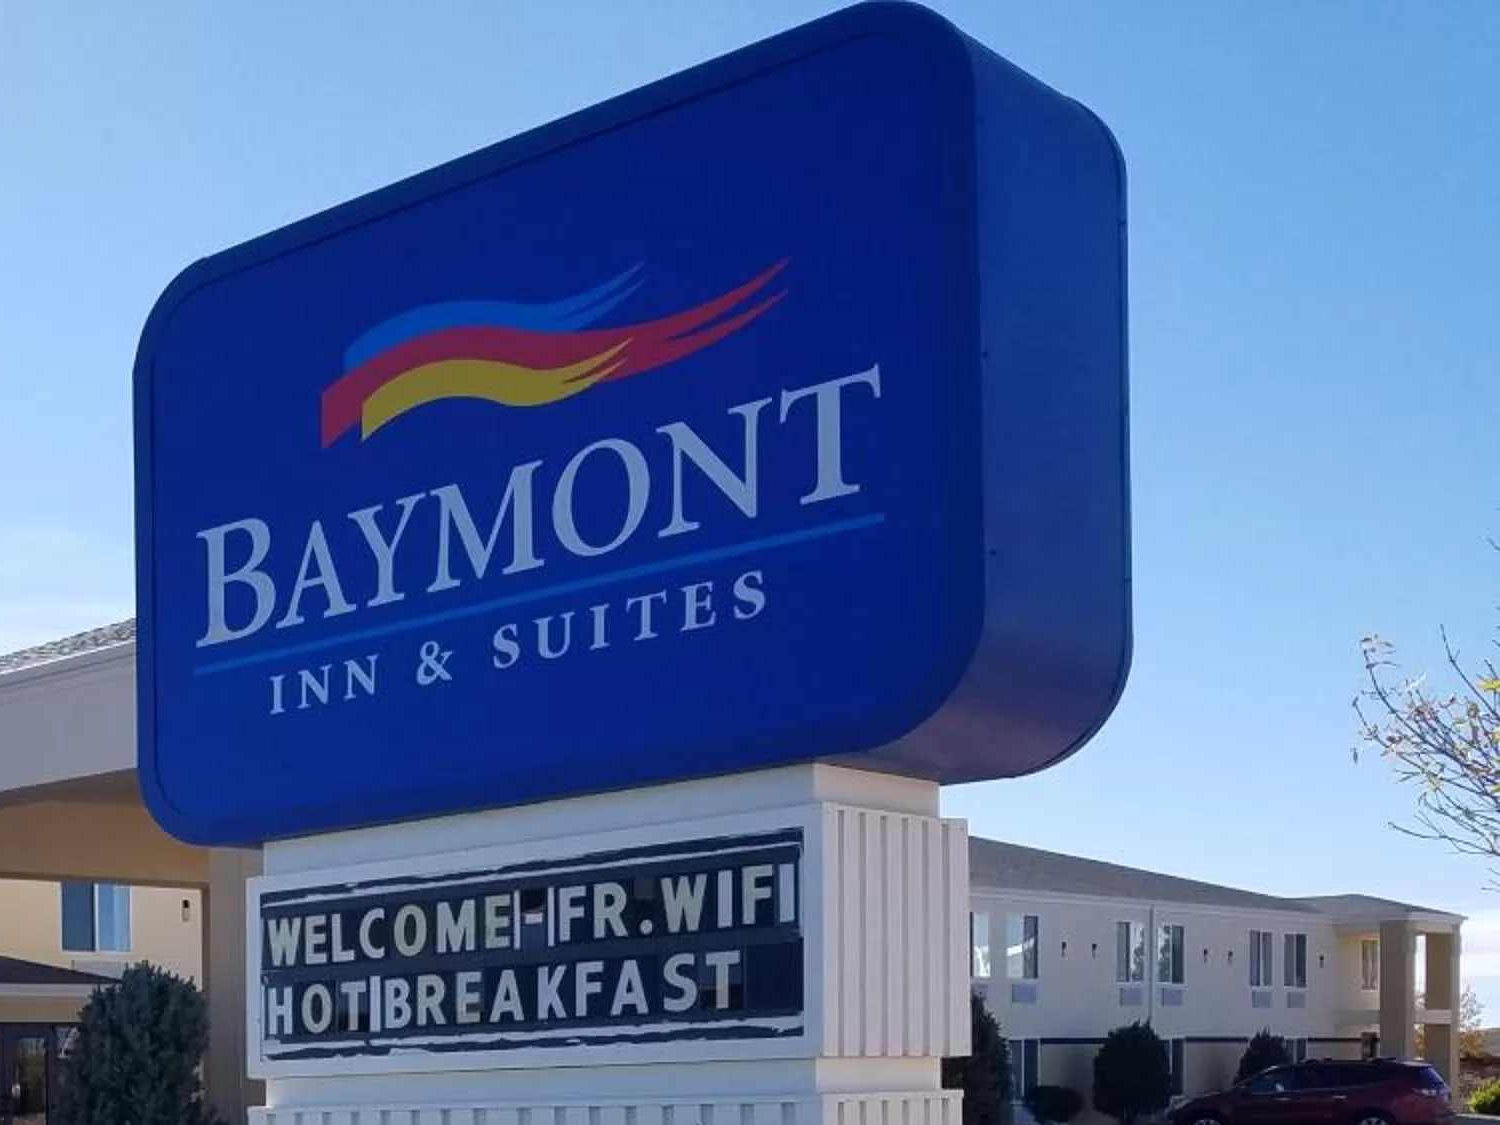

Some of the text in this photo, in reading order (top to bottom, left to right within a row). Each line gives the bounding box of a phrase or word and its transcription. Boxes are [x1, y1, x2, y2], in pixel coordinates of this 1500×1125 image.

[196, 363, 881, 648] BAYMONT
[269, 571, 766, 715] INN & SUITES
[268, 950, 741, 1036] HOT BREAKFAST
